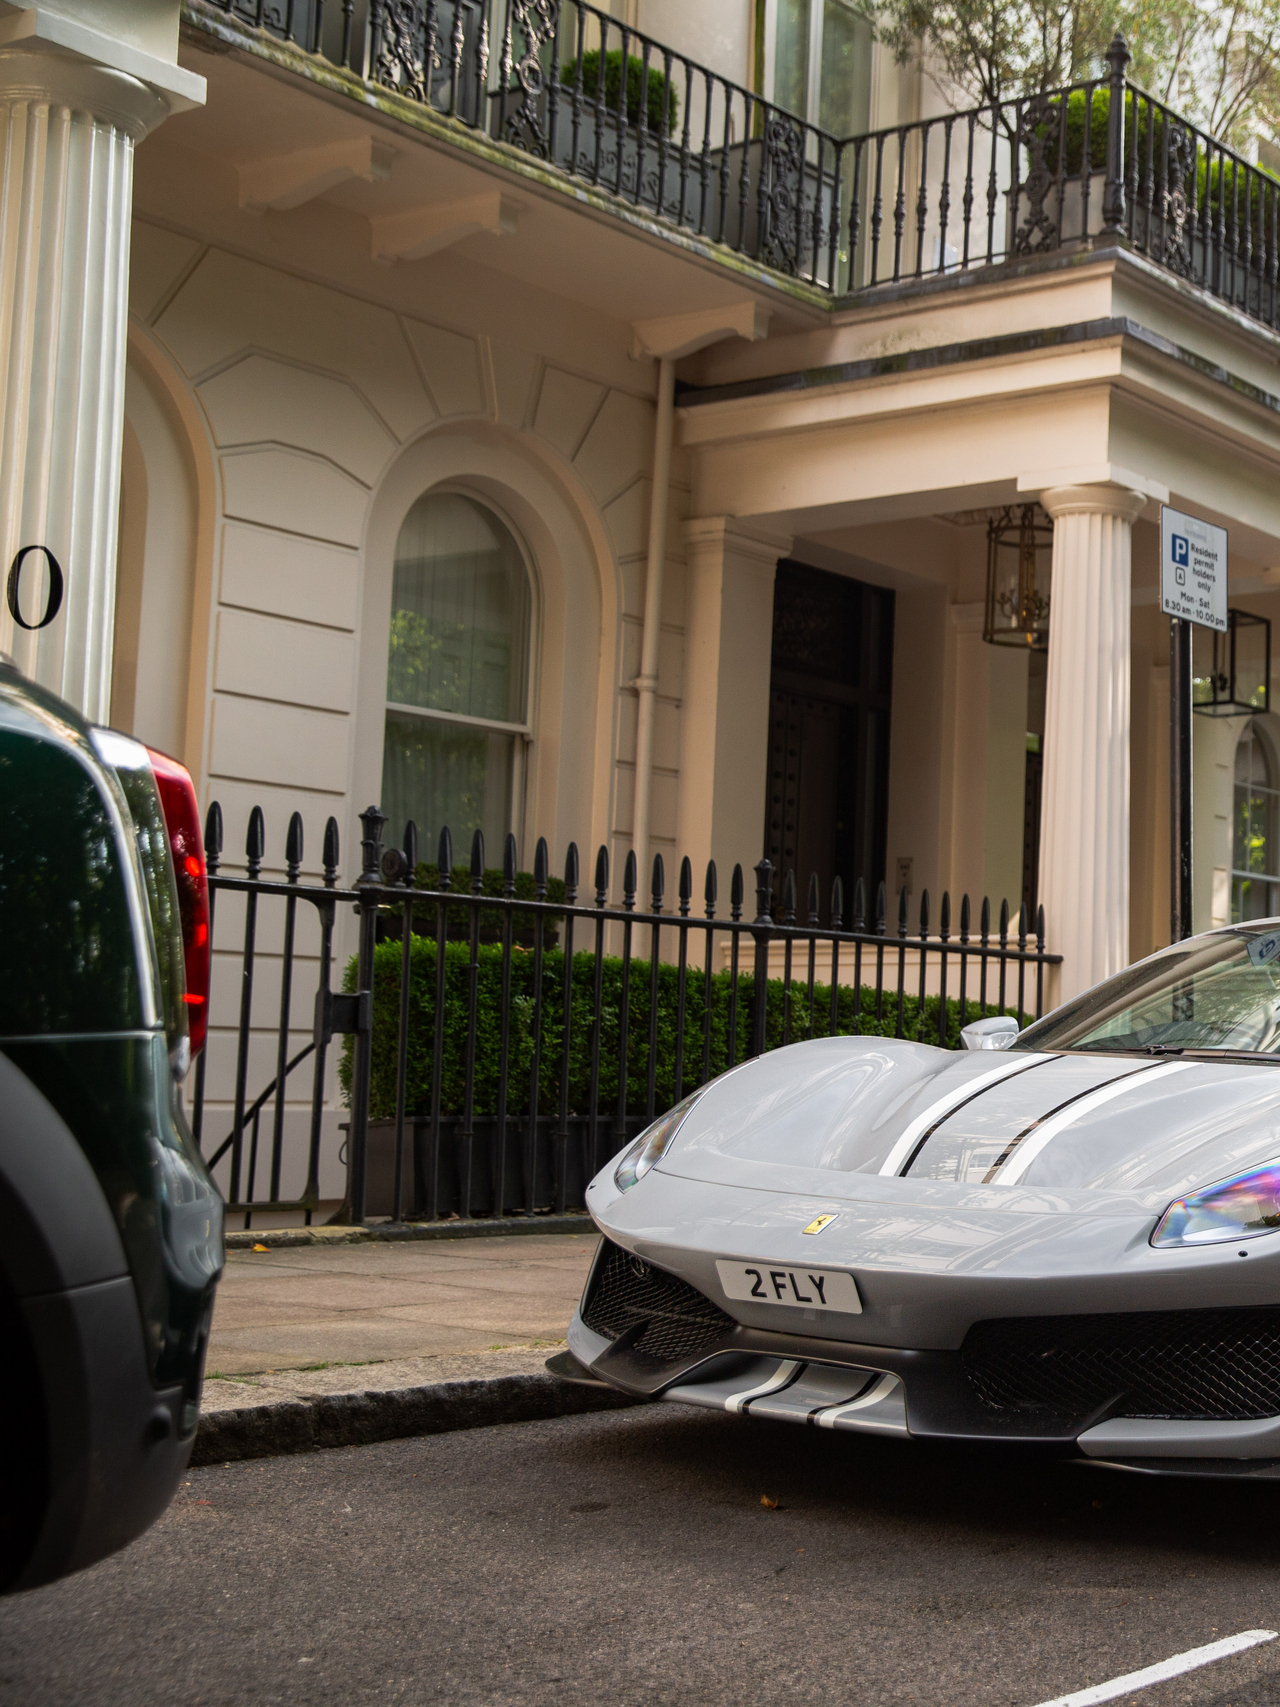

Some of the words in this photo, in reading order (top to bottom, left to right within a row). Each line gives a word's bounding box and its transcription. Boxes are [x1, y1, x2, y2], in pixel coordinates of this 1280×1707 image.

[1175, 537, 1187, 562] P
[1190, 543, 1218, 562] Resident
[1194, 557, 1215, 571] permit
[1192, 566, 1216, 582] holders
[1197, 580, 1211, 593] only
[1180, 590, 1195, 604] Mon
[1199, 597, 1211, 610] Sat
[1164, 598, 1181, 612] 8.30
[1181, 605, 1192, 616] am
[1196, 609, 1215, 624] 10.00
[1215, 616, 1226, 628] pm
[769, 1270, 827, 1305] FLY
